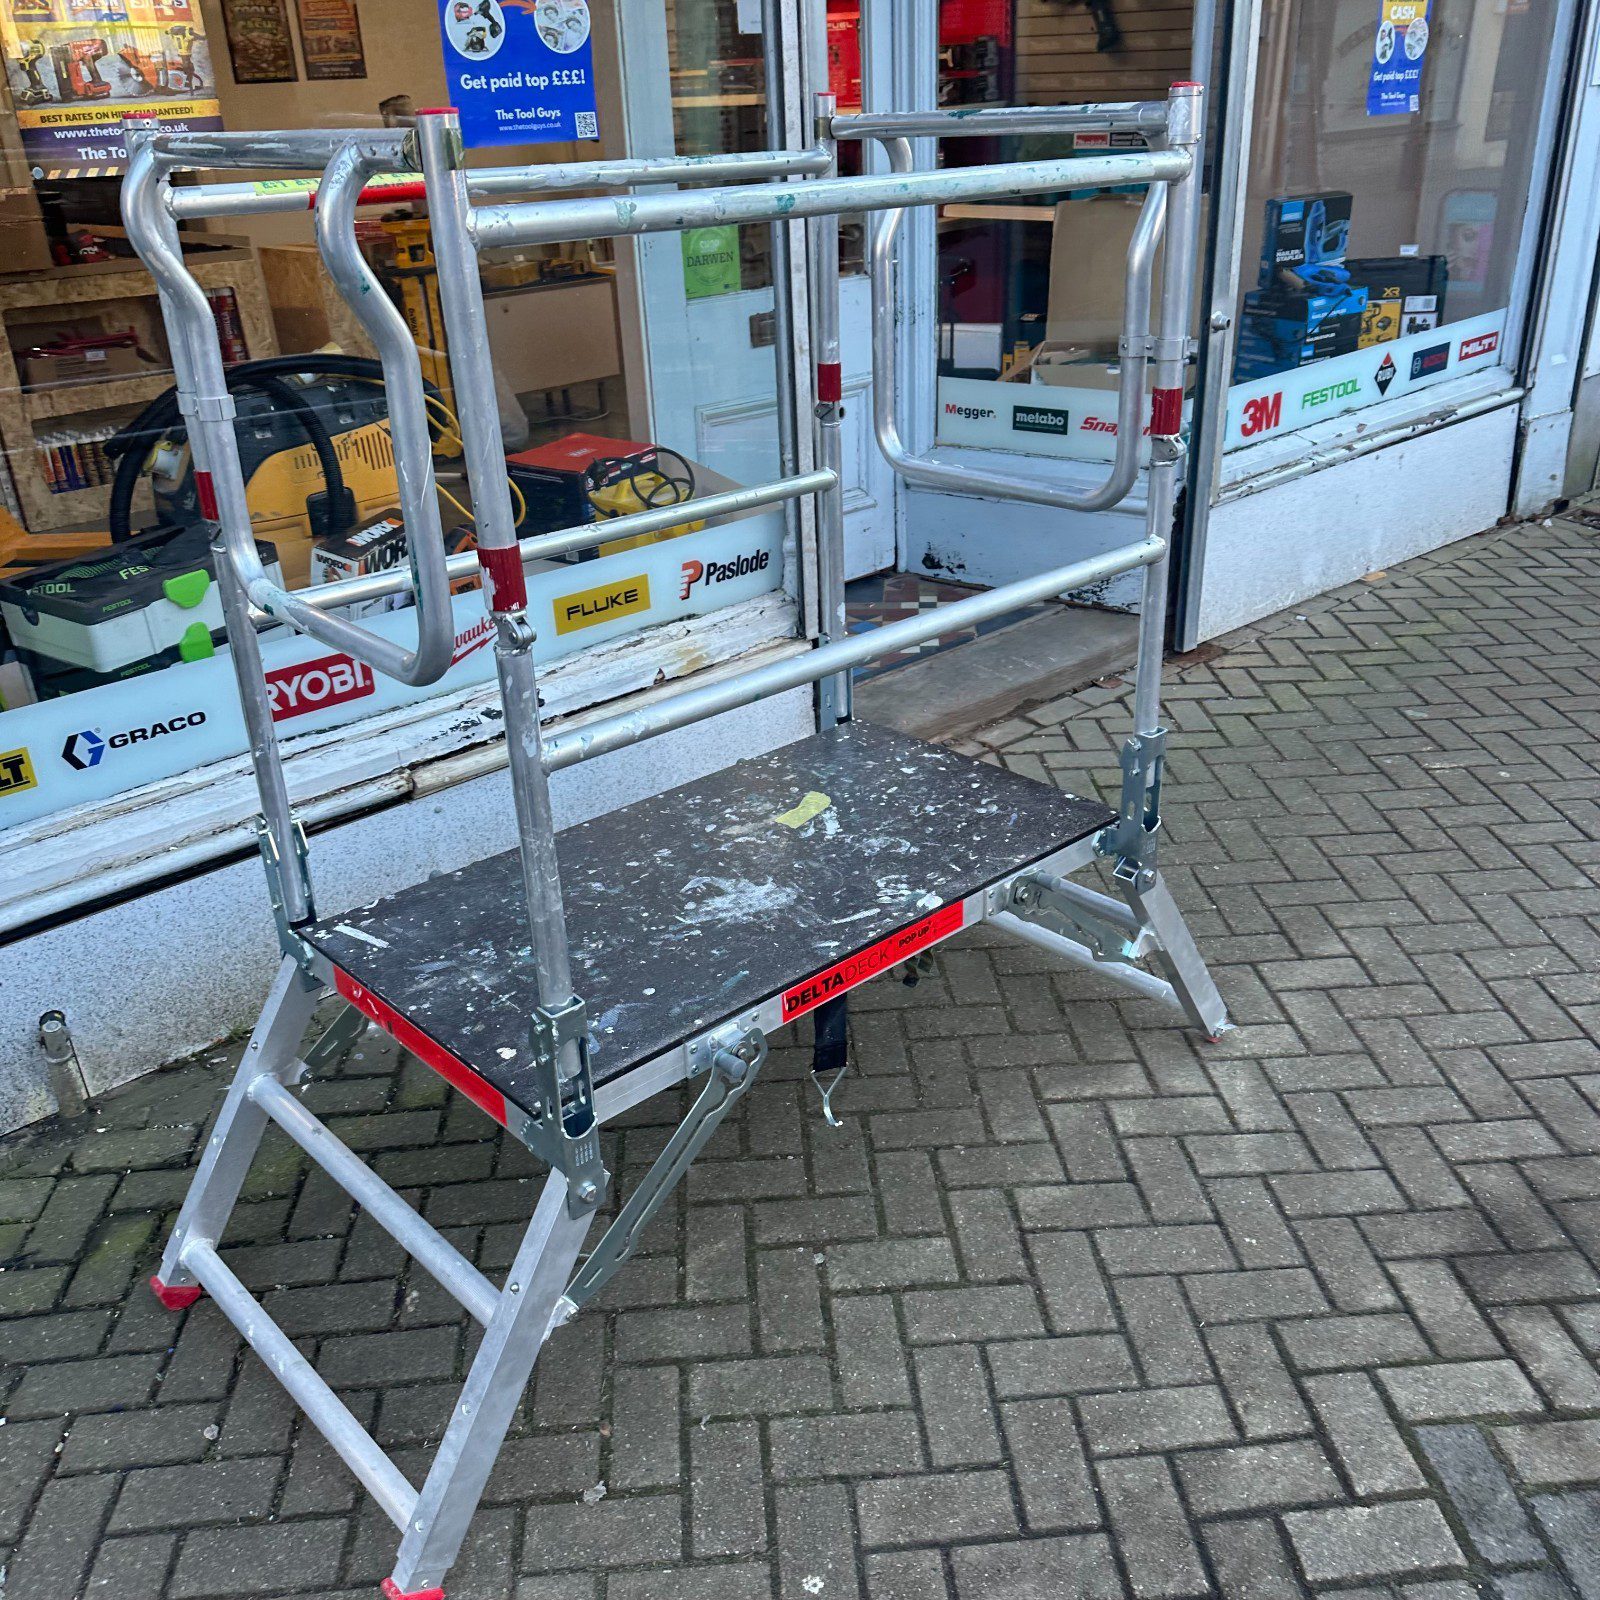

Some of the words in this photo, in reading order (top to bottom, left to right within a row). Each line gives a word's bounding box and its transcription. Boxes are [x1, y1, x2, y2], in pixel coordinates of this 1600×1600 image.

[1391, 6, 1416, 19] CASH
[460, 74, 487, 90] Get
[490, 71, 522, 92] paid
[525, 73, 548, 90] top
[552, 69, 586, 86] £££!
[1373, 71, 1383, 81] Get
[40, 115, 63, 124] BEST
[65, 111, 94, 122] RATES
[95, 111, 110, 120] ON
[495, 108, 514, 120] The
[514, 107, 535, 119] Tool
[536, 106, 561, 120] Guys
[78, 147, 107, 160] The
[108, 146, 127, 159] To
[686, 251, 734, 268] DARWEN
[1382, 286, 1400, 298] XR
[1461, 335, 1496, 358] HILTI
[945, 403, 995, 420] Megger
[1015, 412, 1065, 426] metabo
[1241, 391, 1283, 437] 3M
[1301, 378, 1362, 410] FESTOOL
[350, 520, 394, 546] WORX
[705, 548, 769, 586] Paslode
[103, 598, 134, 612] FESTOOL
[566, 588, 639, 621] FLUKE
[266, 660, 364, 711] RYOBI
[108, 711, 207, 749] GRACO
